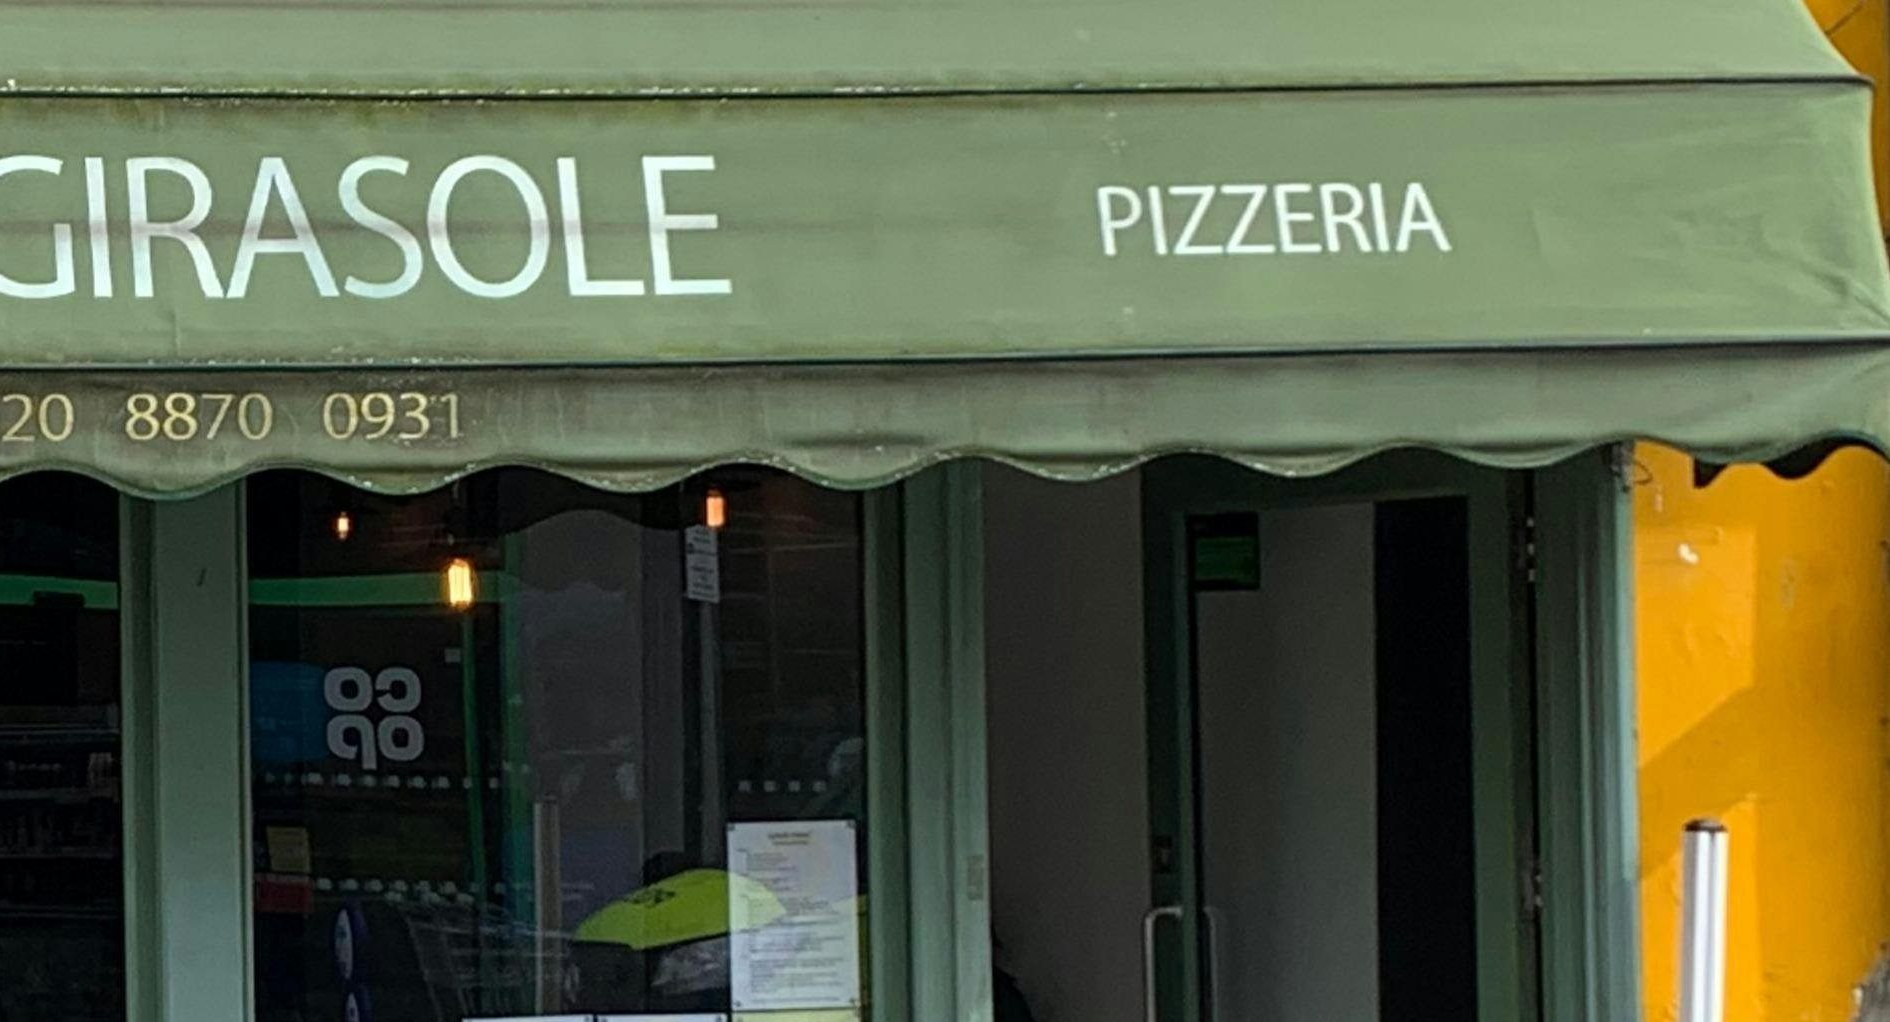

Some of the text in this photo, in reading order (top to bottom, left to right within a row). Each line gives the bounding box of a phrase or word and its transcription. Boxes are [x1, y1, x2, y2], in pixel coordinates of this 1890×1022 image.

[1097, 182, 1452, 257] PIZZERIA
[124, 391, 274, 441] 8870
[322, 391, 462, 441] 0931
